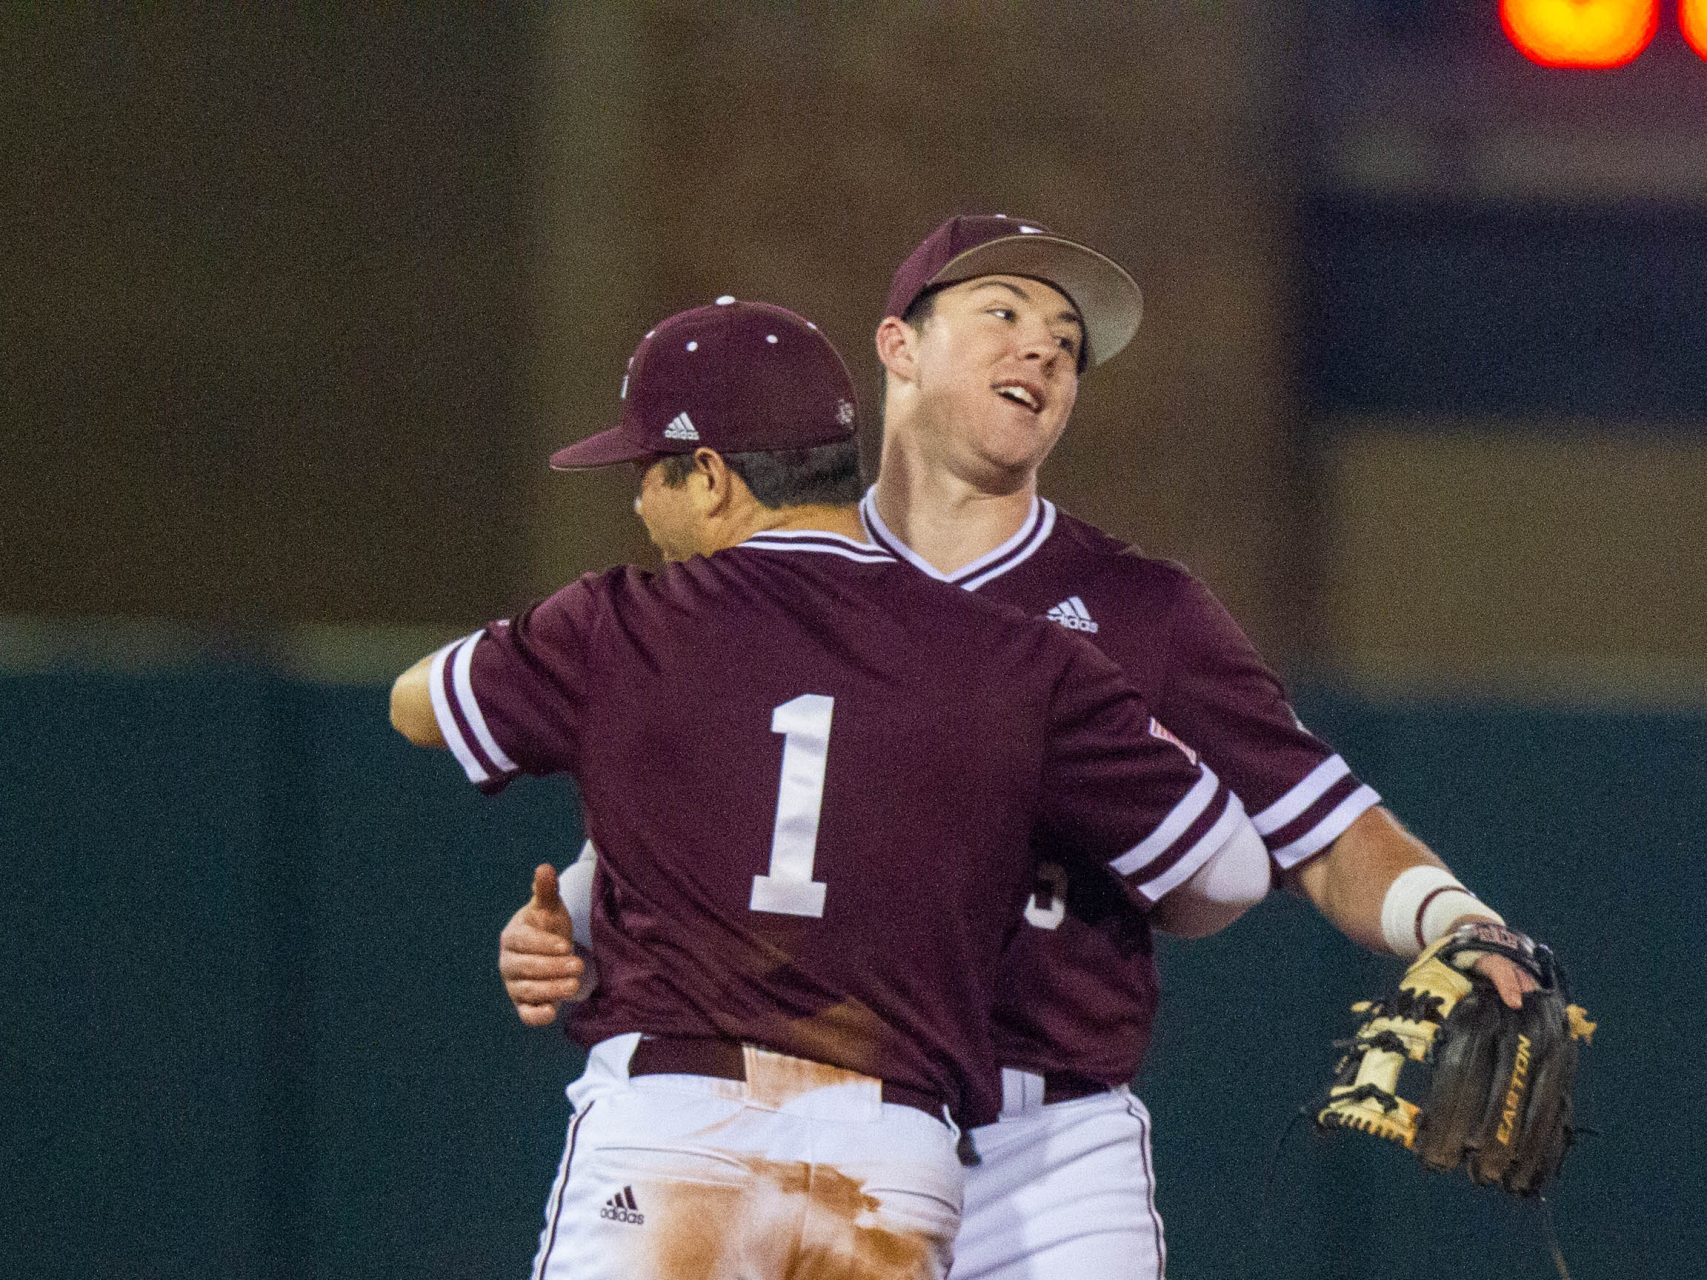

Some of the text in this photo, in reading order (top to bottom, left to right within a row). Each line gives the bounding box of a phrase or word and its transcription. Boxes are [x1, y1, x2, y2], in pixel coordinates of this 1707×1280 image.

[664, 429, 699, 440] adidas
[749, 694, 834, 918] 1
[600, 1206, 645, 1225] adidas
